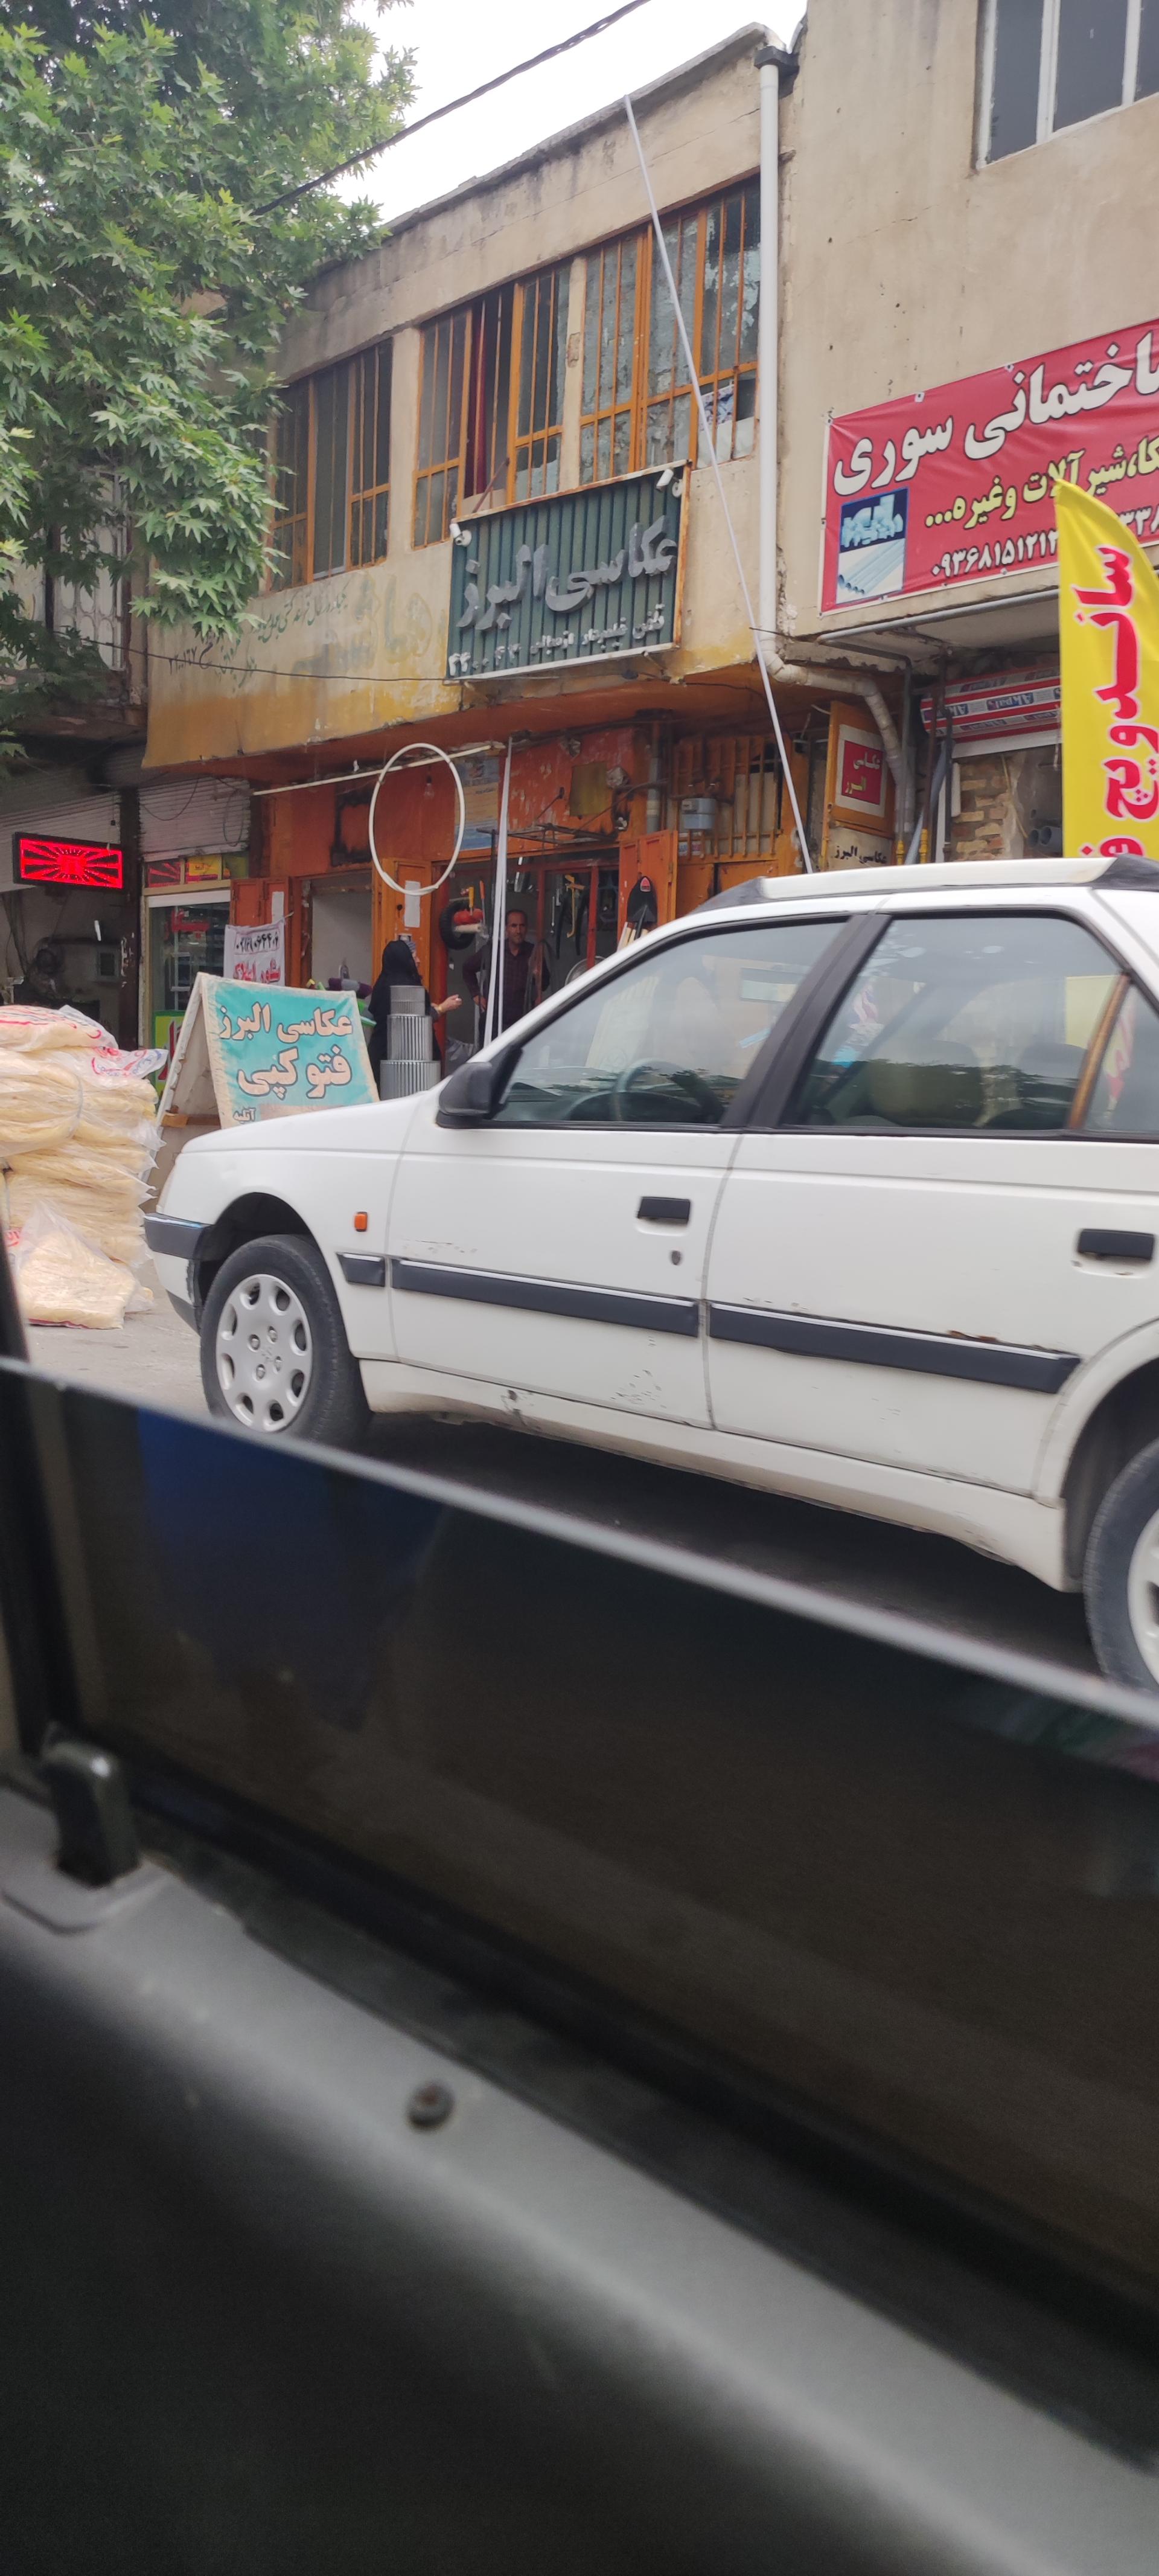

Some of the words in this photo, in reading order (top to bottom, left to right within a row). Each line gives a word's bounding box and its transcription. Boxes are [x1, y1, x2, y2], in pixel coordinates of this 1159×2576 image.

[964, 331, 1159, 461] اختمانی
[832, 415, 953, 497] سوری
[456, 543, 549, 630] البرز
[544, 514, 677, 612] عکاسی
[1071, 546, 1159, 819] ساندویچ
[834, 845, 858, 860] البرز
[858, 851, 888, 864] عکاسی
[219, 1001, 271, 1040] البرز
[277, 1007, 353, 1043] عکاسی
[236, 1046, 299, 1100] کپی
[306, 1044, 353, 1099] فتو
